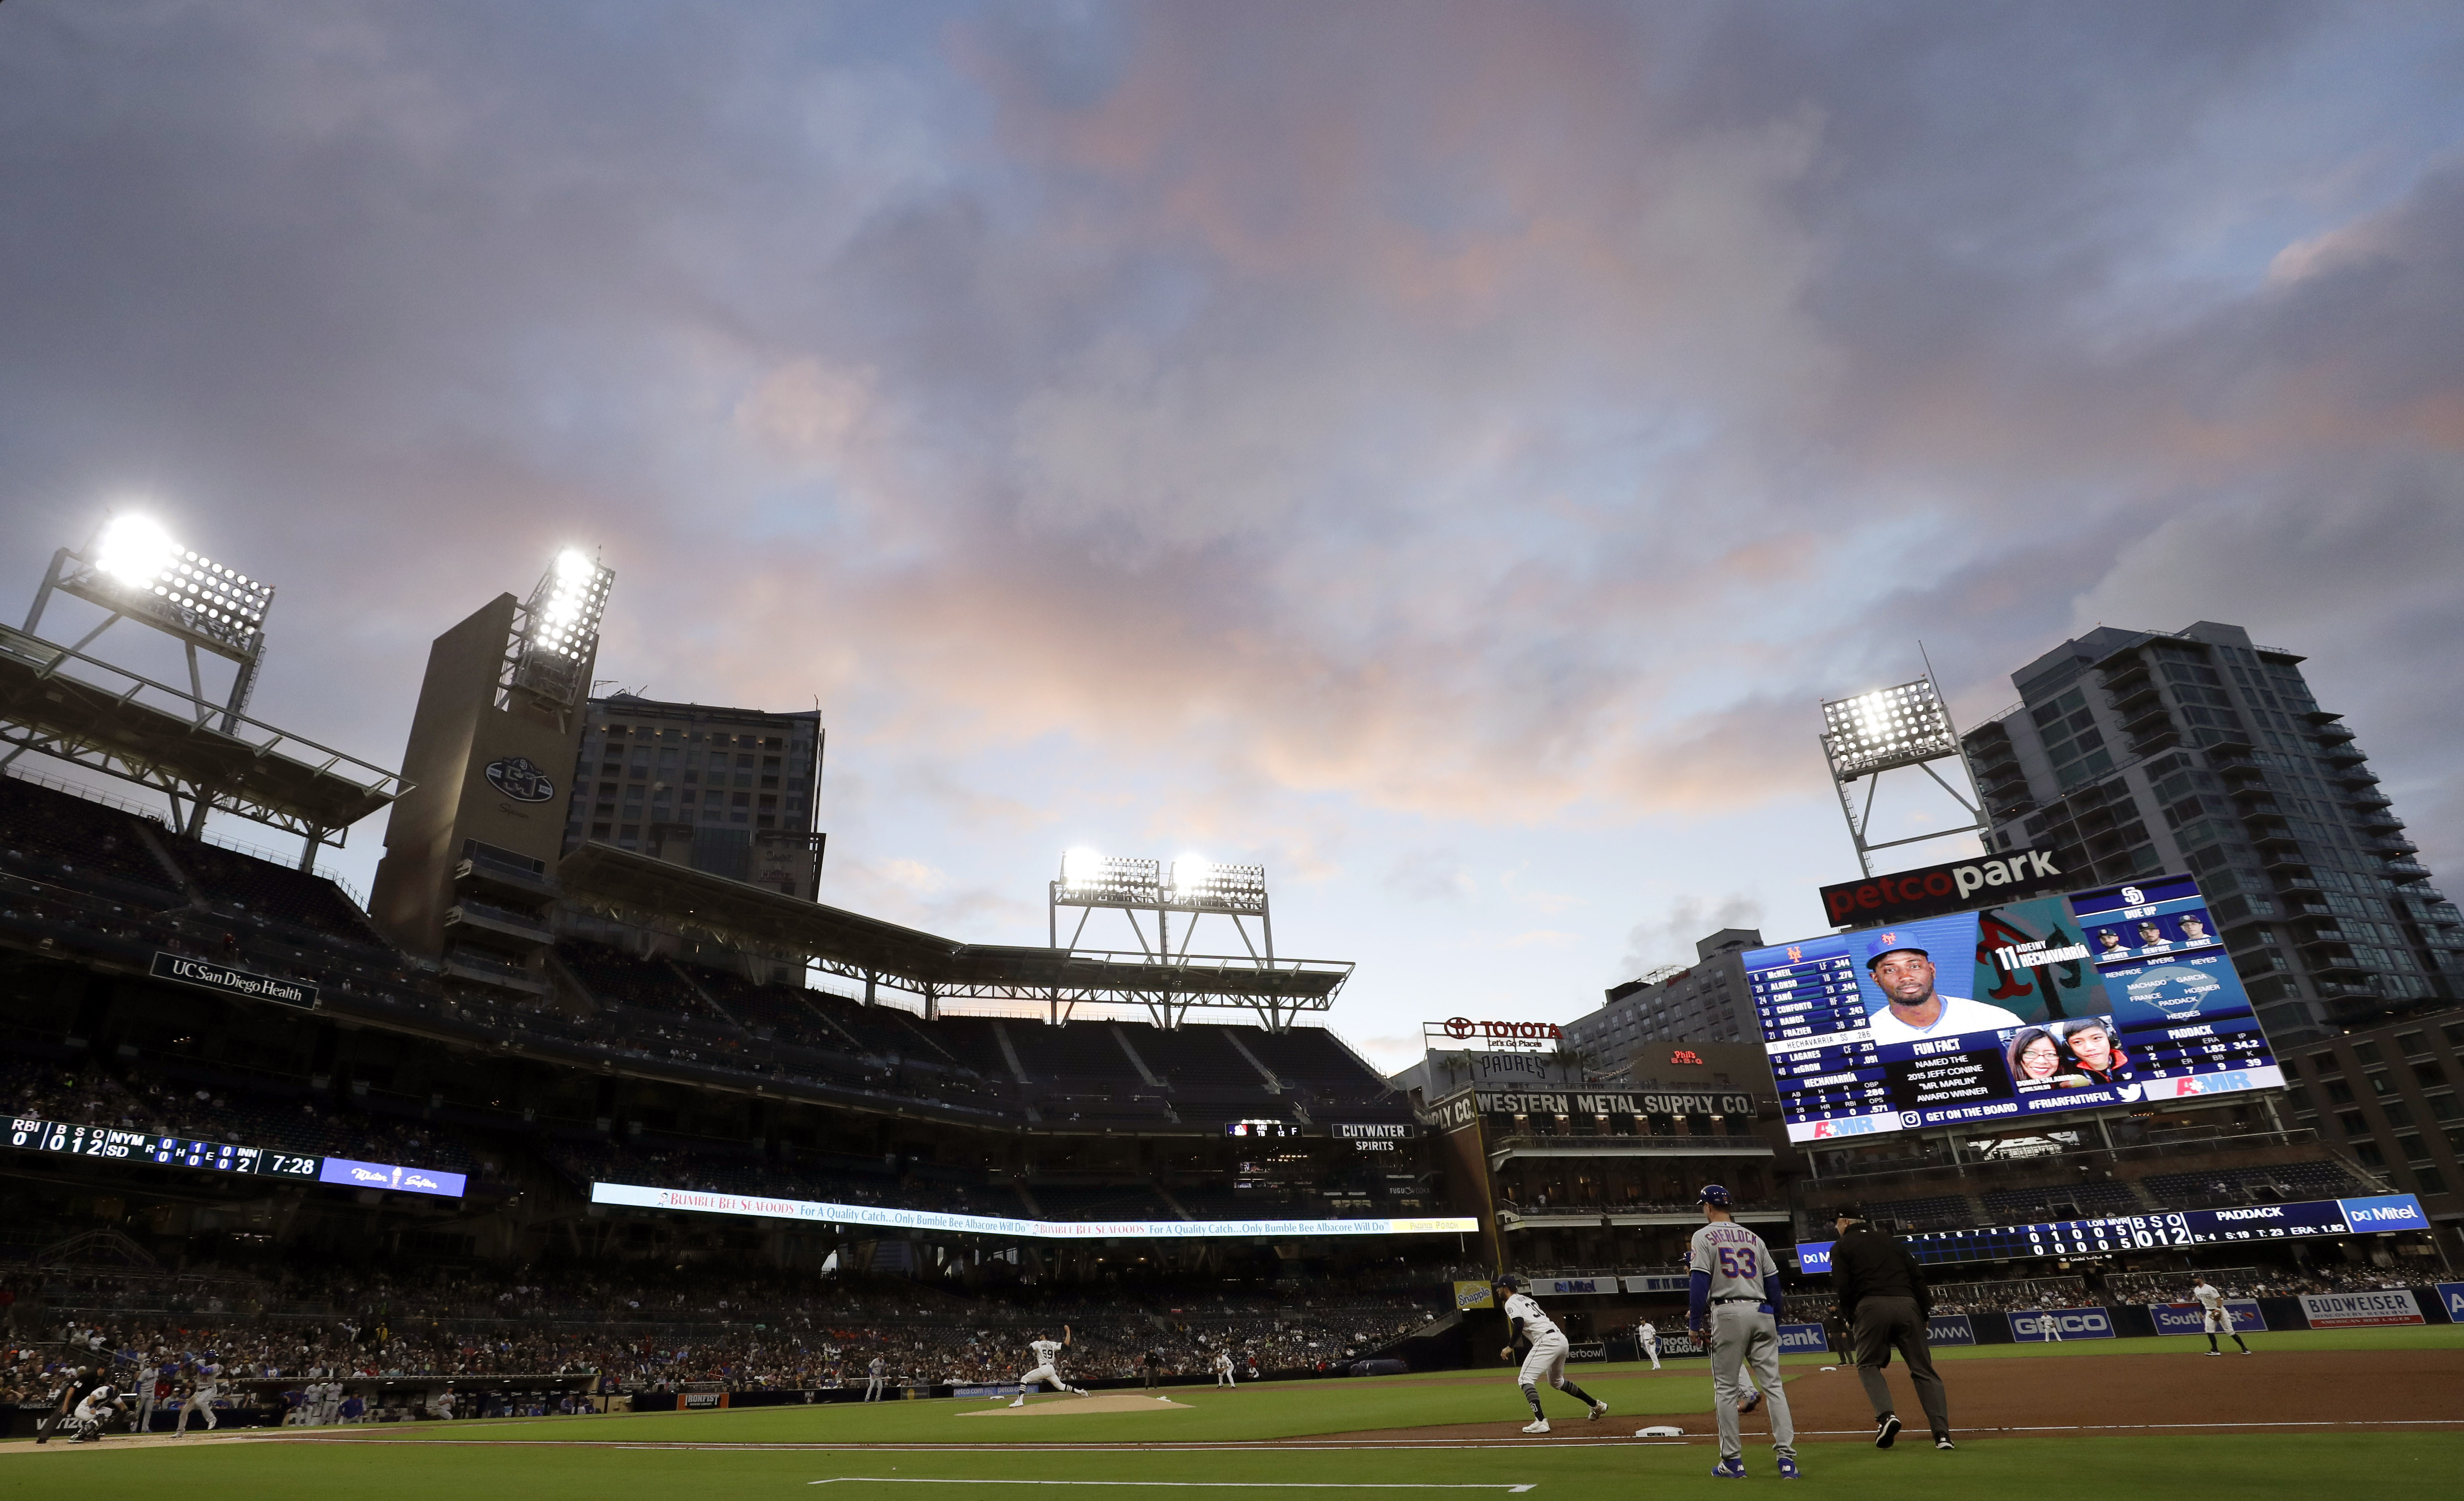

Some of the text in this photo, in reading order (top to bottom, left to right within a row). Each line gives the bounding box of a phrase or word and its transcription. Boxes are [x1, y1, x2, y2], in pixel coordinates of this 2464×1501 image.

[2124, 906, 2156, 919] DUE UP
[1995, 940, 2047, 970] 11 ADEINY
[2019, 942, 2090, 967] HECHAVARRÍA
[2101, 938, 2212, 962] HOSMER RENFROE FRANCE
[1767, 959, 1849, 979] McNEIL .344
[2147, 957, 2217, 965] MYERS REYES
[174, 960, 303, 1002] UC San Diego Health
[1771, 971, 1853, 990] ALONSO .278
[2105, 968, 2143, 979] RENFROE
[1842, 982, 1856, 991] .244
[2127, 974, 2207, 992] MACHADO GARCIA
[2129, 982, 2220, 1003] FRANCE HOSMER
[2157, 995, 2199, 1007] PADDACK
[1776, 994, 1859, 1014] CONFORTO .267
[1779, 1006, 1863, 1025] RAMOS .243
[2165, 1009, 2200, 1019] HEDGES
[1481, 1021, 1564, 1040] TOYOTA
[1783, 1018, 1865, 1039] FRAZIER .167
[2168, 1025, 2213, 1041] PADDACK
[1517, 1040, 1542, 1048] Places
[1786, 1030, 1871, 1051] HECHAVARRÍA .286
[1913, 1038, 1960, 1055] FUN FACT
[2202, 1040, 2259, 1053] 1.82 34.2
[1789, 1043, 1874, 1061] LAGARES .213
[1864, 1055, 1878, 1064] .091
[1482, 1053, 1546, 1079] PADRES
[1915, 1055, 1968, 1068] NAMED THE
[1927, 1069, 1946, 1078] JEFF
[1947, 1064, 1983, 1075] CONINE
[1804, 1072, 1857, 1089] HECHAVARRÍA
[1943, 1076, 1977, 1087] MARLIN"
[2016, 1077, 2041, 1088] DONNA
[2177, 1071, 2253, 1096] AMR
[1864, 1088, 1884, 1097] .286
[1918, 1087, 1988, 1102] AWARD WINNER
[2028, 1092, 2114, 1109] #FRIARFAITHFUL
[1477, 1094, 1755, 1114] WESTERN METAL SUPPLY CO.
[1926, 1103, 2018, 1121] GET ON THE BOARD
[12, 1119, 41, 1132] RBI
[1342, 1125, 1405, 1137] CUTWATER
[1814, 1117, 1876, 1139] AMR
[110, 1132, 145, 1146] NYM
[1356, 1142, 1394, 1150] SPIRITS
[106, 1145, 128, 1157] SD
[273, 1155, 314, 1174] 7:28
[670, 1193, 715, 1208] BUMBLE
[718, 1197, 738, 1210] BEE
[740, 1199, 793, 1214] SEAFOODS
[800, 1205, 817, 1216] For
[817, 1207, 824, 1217] A
[827, 1207, 859, 1224] Quality
[917, 1215, 947, 1227] Bumble
[949, 1217, 963, 1228] Bee
[965, 1219, 997, 1231] Albacore
[1000, 1221, 1013, 1232] Will
[2215, 1206, 2284, 1221] PADDACK
[2372, 1205, 2418, 1220] Mitel
[1040, 1225, 1074, 1234] BUMBLE
[1076, 1225, 1092, 1234] BEE
[1095, 1224, 1144, 1234] SEAFOODS
[1149, 1225, 1163, 1235] For
[1166, 1225, 1173, 1234] A
[1175, 1224, 1206, 1237] Quality
[1265, 1222, 1297, 1233] Bumble
[1299, 1222, 1314, 1233] Bee
[1317, 1221, 1352, 1232] Albacore
[1354, 1220, 1370, 1232] Will
[1705, 1229, 1757, 1247] SHERLOCK
[1718, 1247, 1756, 1278] 53
[1568, 1280, 1595, 1293] Mitel
[1458, 1287, 1490, 1306] Snapple
[2307, 1295, 2408, 1313] BUDWEISER
[1042, 1349, 1053, 1359] 59
[685, 1394, 719, 1406] IRONFIST
[954, 1387, 983, 1396] petco.com
